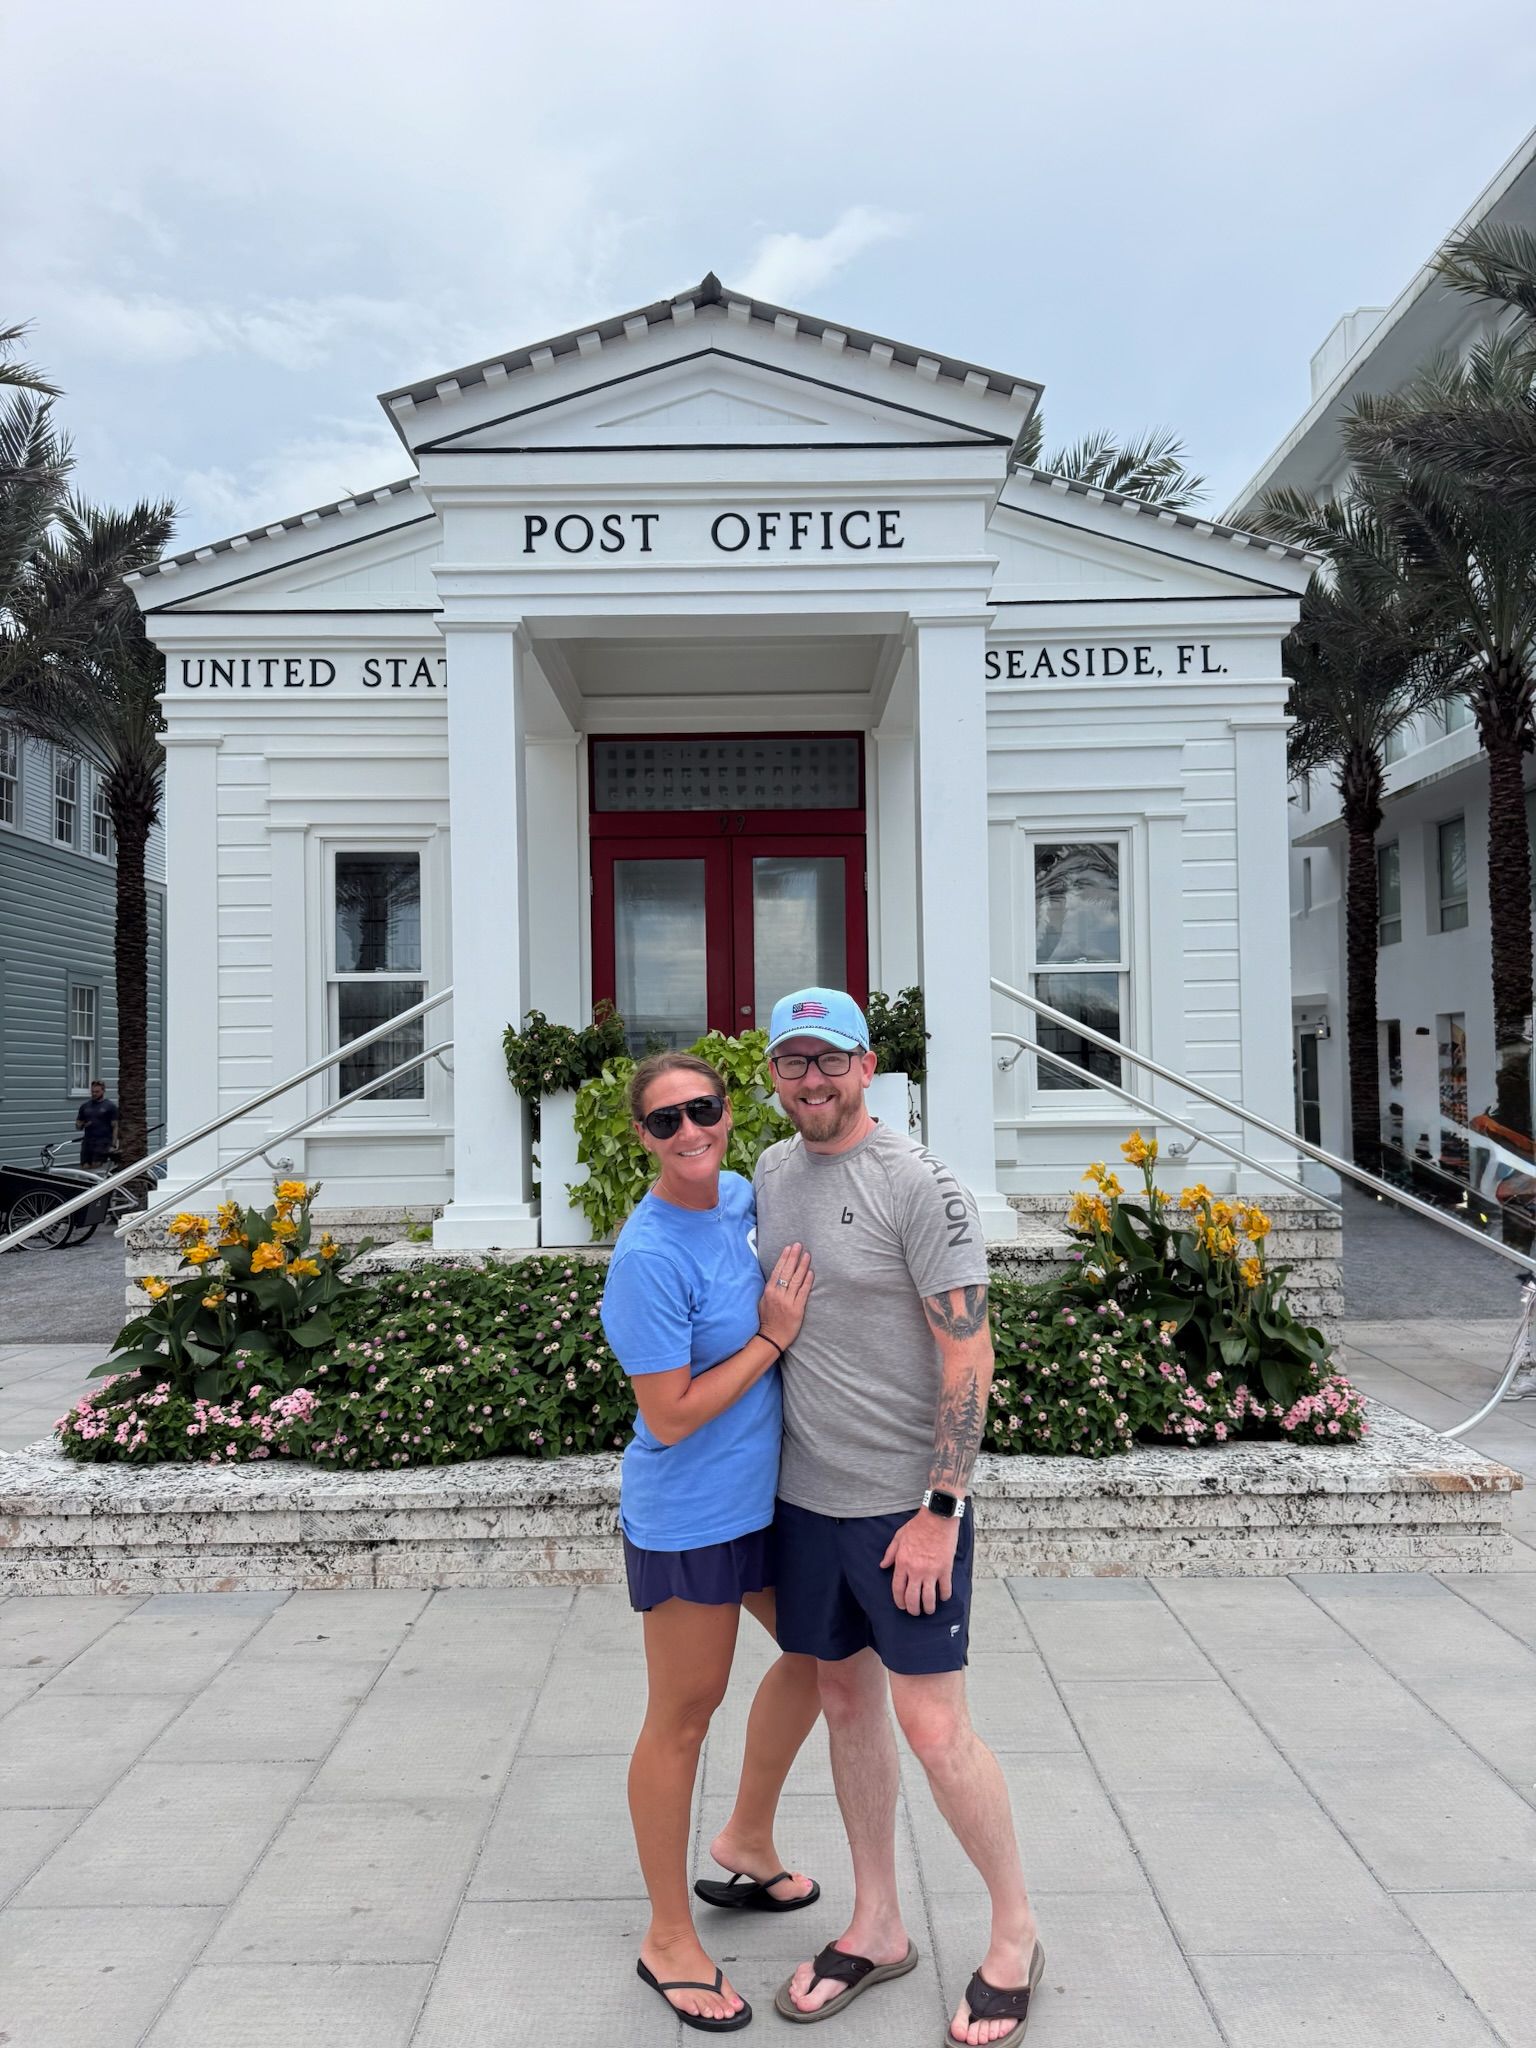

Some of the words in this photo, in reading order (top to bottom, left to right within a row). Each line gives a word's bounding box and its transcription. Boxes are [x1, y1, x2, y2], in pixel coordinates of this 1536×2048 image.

[523, 515, 660, 553] POST
[712, 511, 905, 551] OFFICE
[181, 659, 335, 688] UNITED
[985, 647, 1162, 680] SEASIDE,
[1177, 645, 1230, 674] FL.
[910, 1146, 973, 1248] NATION
